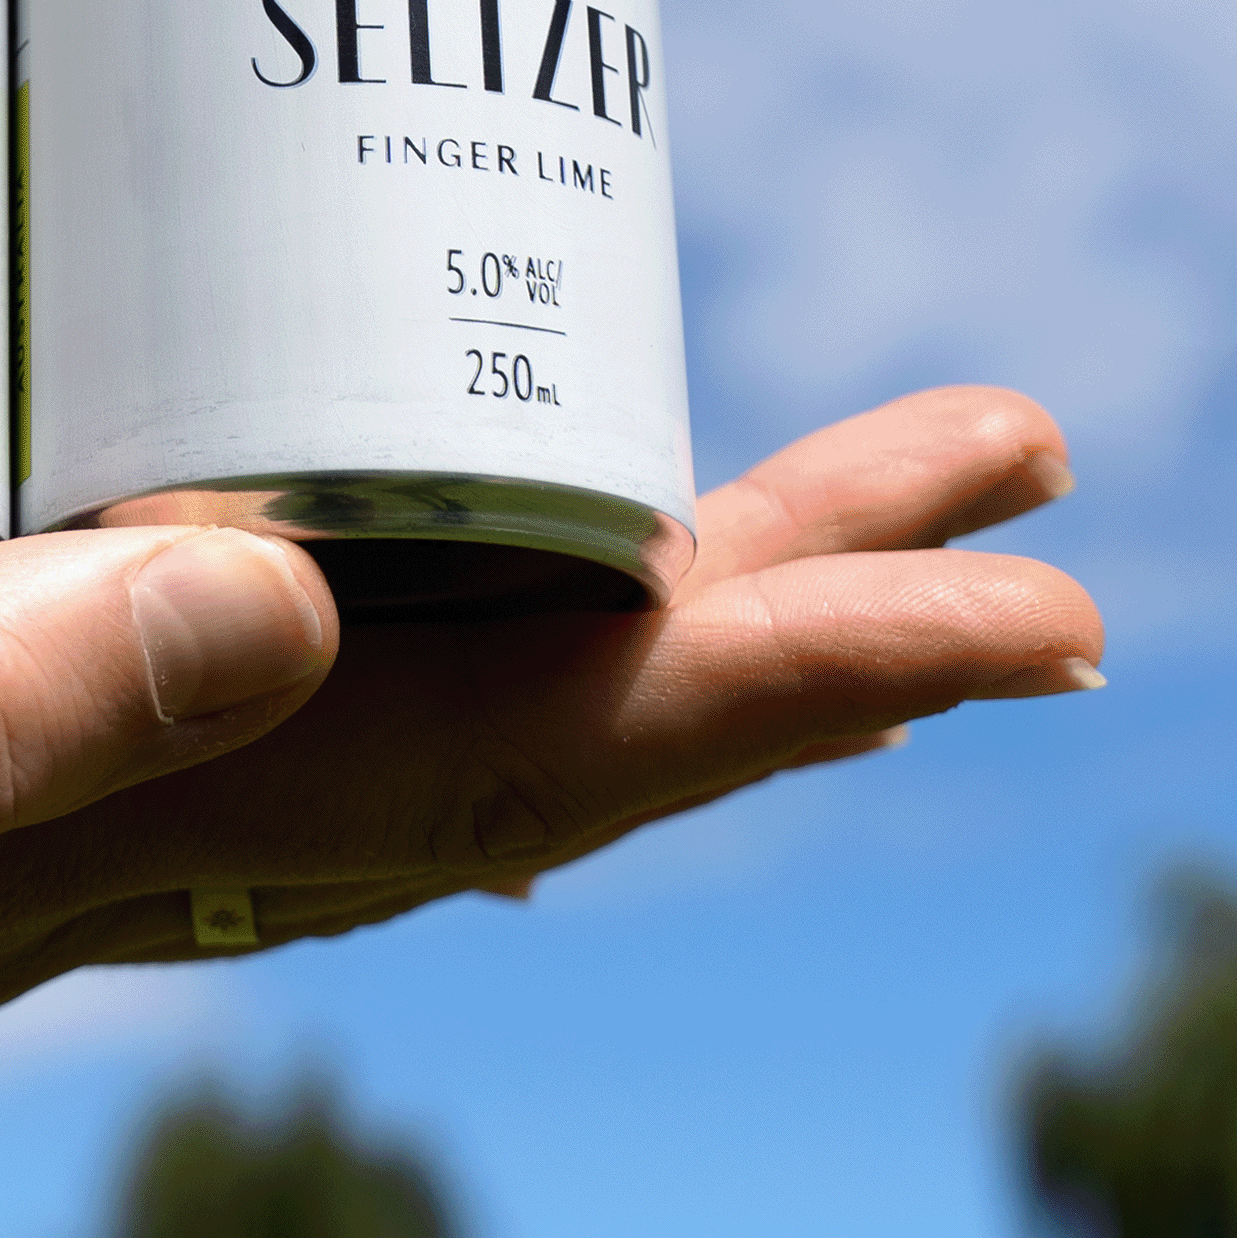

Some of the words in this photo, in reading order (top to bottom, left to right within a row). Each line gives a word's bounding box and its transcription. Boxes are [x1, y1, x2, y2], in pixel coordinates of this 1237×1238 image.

[357, 134, 520, 176] FINGER
[537, 150, 614, 200] LIME
[446, 248, 520, 299] 5.0%
[525, 256, 563, 290] ALC/
[525, 279, 562, 308] VOL
